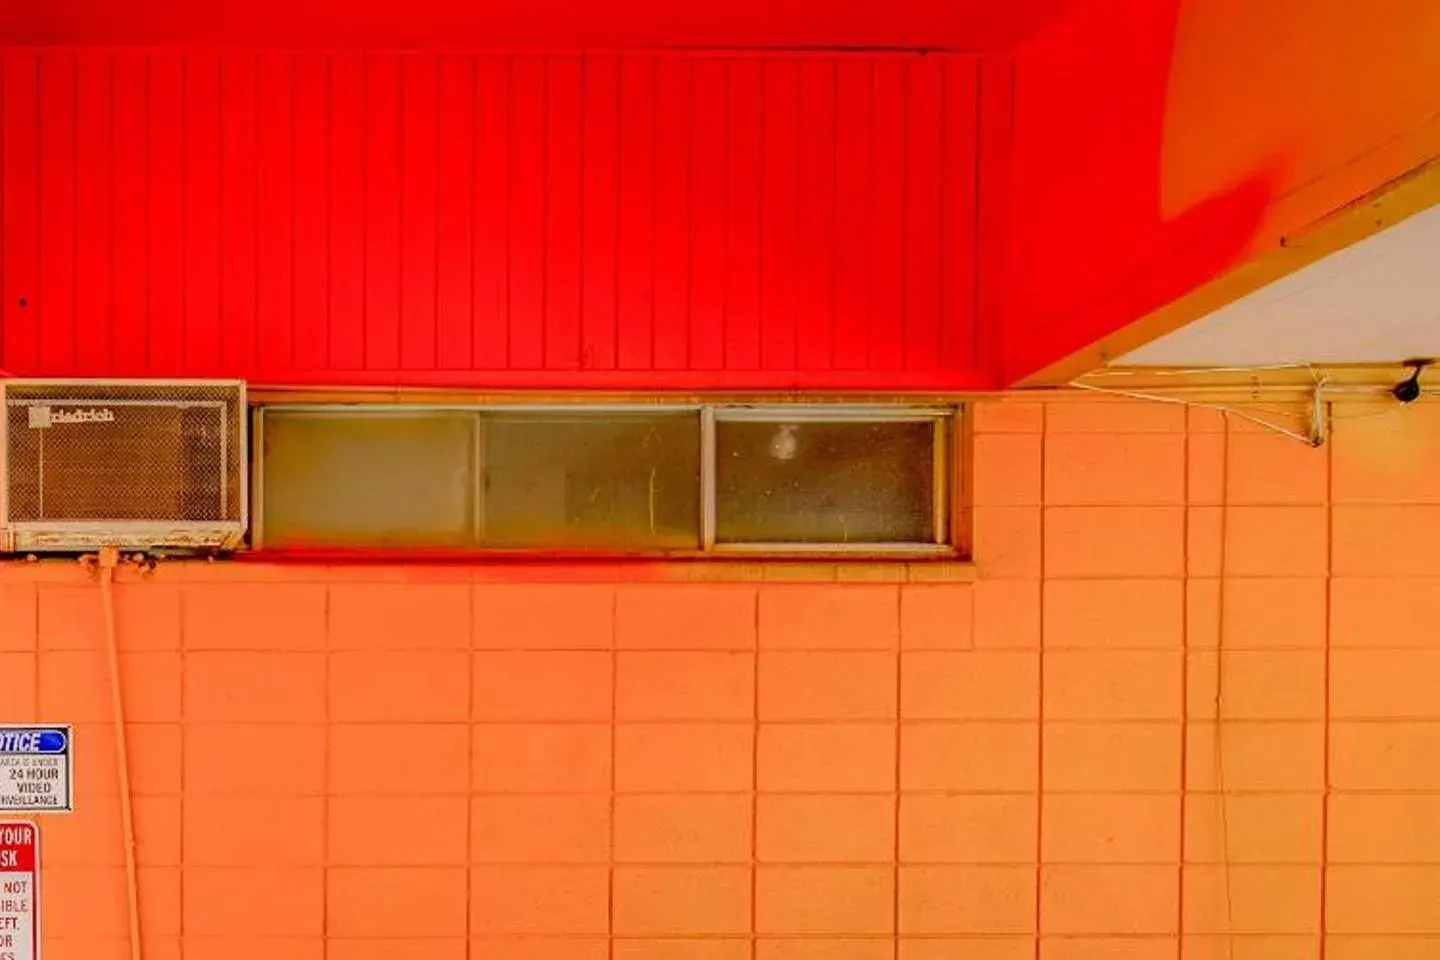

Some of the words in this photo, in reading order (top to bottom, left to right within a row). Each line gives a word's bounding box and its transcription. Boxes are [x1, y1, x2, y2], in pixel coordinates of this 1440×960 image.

[9, 768, 24, 780] 24
[27, 768, 58, 780] HOUR
[17, 781, 51, 794] VIDEO
[3, 881, 27, 894] NOT
